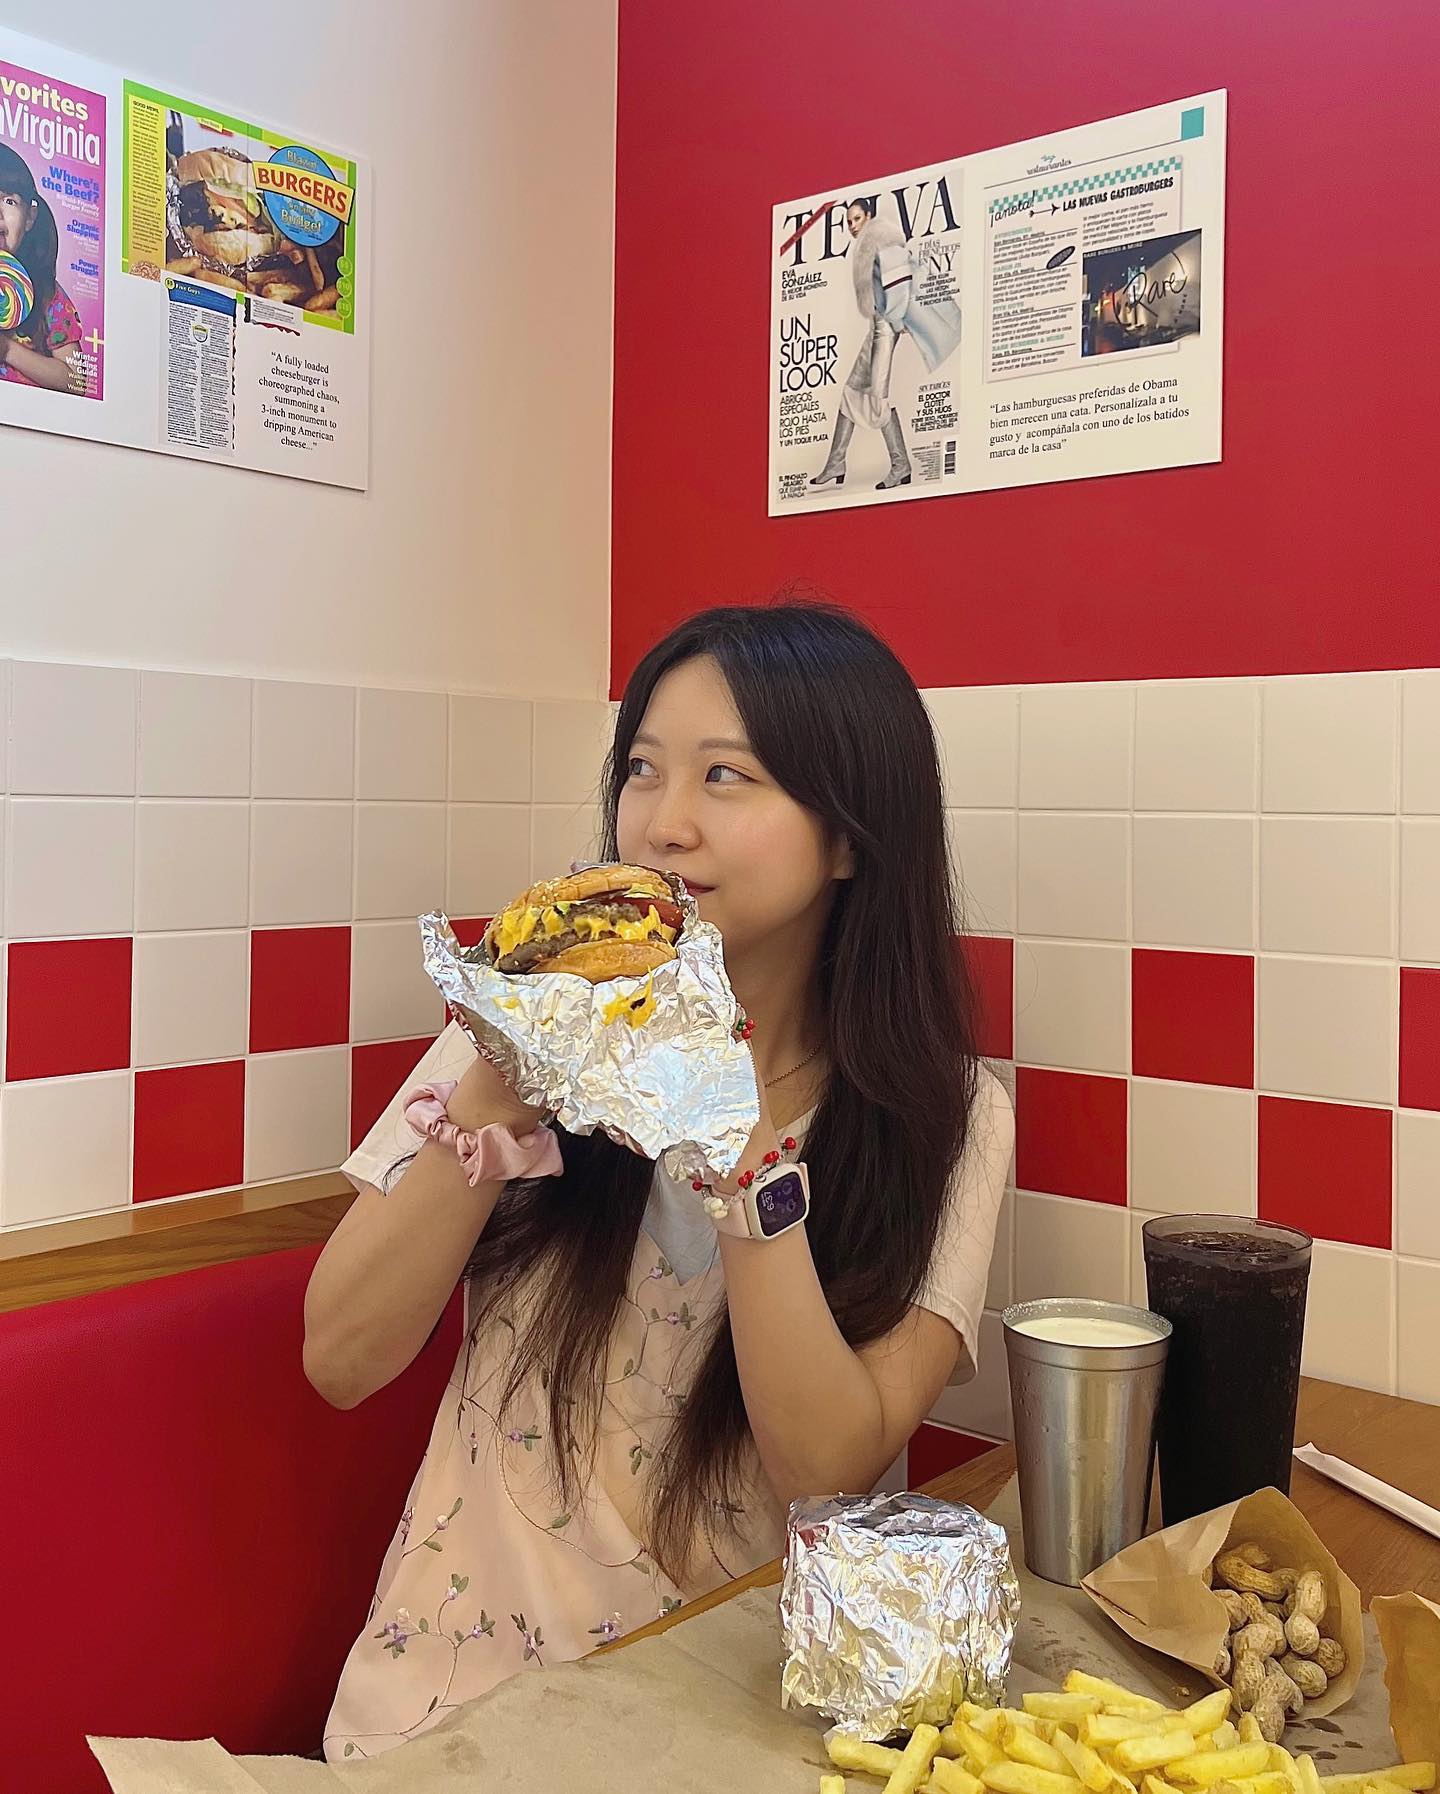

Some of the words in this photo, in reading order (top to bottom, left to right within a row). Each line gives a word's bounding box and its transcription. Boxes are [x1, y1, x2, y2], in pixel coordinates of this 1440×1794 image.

[42, 177, 62, 193] the
[65, 184, 99, 204] Beef?
[257, 168, 346, 214] BURGERS
[1063, 199, 1076, 211] LAS
[1079, 192, 1107, 208] NUEVAS
[1110, 177, 1174, 200] GASTROBURGERS
[990, 190, 1036, 227] ¡anota!
[67, 224, 99, 240] Shopping
[72, 219, 99, 233] Organic
[71, 264, 98, 276] Struggle
[79, 259, 98, 270] Power
[928, 251, 955, 275] NY
[782, 269, 796, 280] EVA
[782, 272, 822, 289] GONZÁLEZ
[788, 286, 802, 294] MEJOR
[804, 281, 828, 290] MOMENTO
[1123, 272, 1188, 324] Rare
[780, 314, 810, 342] UN
[73, 350, 98, 362] Winter
[780, 334, 838, 368] SÚPER
[66, 356, 97, 371] Wedding
[77, 366, 97, 377] Guide
[285, 355, 303, 368] fully
[304, 360, 329, 374] loaded
[271, 366, 320, 386] cheeseburger
[322, 377, 328, 387] is
[780, 360, 837, 393] LOOK
[258, 377, 314, 397] choreographed
[317, 390, 340, 404] chaos,
[780, 392, 812, 406] ABRIGOS
[926, 391, 950, 401] DOCTOR
[1013, 393, 1077, 411] hamburguesas
[1079, 386, 1125, 402] preferidas
[1128, 382, 1140, 392] de
[1142, 378, 1178, 390] Obama
[274, 395, 318, 413] summoning
[780, 401, 819, 416] ESPECIALES
[922, 408, 933, 416] SUS
[935, 405, 952, 414] HIJOS
[924, 399, 944, 408] CLOTET
[990, 419, 1009, 429] bien
[1011, 414, 1048, 426] merecen
[1051, 411, 1067, 420] una
[1070, 407, 1091, 417] cata.
[1094, 395, 1157, 414] Personalízala
[1160, 396, 1165, 404] a
[1168, 394, 1178, 403] tu
[261, 404, 286, 418] 3-inch
[288, 412, 327, 426] monument
[780, 416, 800, 428] ROJO
[802, 412, 826, 424] HASTA
[264, 419, 296, 435] dripping
[298, 426, 334, 441] American
[780, 428, 793, 438] LOS
[796, 425, 809, 436] PIES
[990, 434, 1013, 446] gusto
[1015, 432, 1022, 442] y
[1026, 423, 1080, 439] acompáñala
[1083, 421, 1099, 430] con
[1102, 419, 1120, 428] uno
[1123, 415, 1134, 425] de
[1137, 412, 1150, 423] los
[1154, 407, 1190, 420] batidos
[794, 436, 812, 445] TOQUE
[813, 434, 828, 442] PLATA
[989, 448, 1016, 459] marca
[1018, 445, 1029, 454] de
[1032, 443, 1040, 453] la
